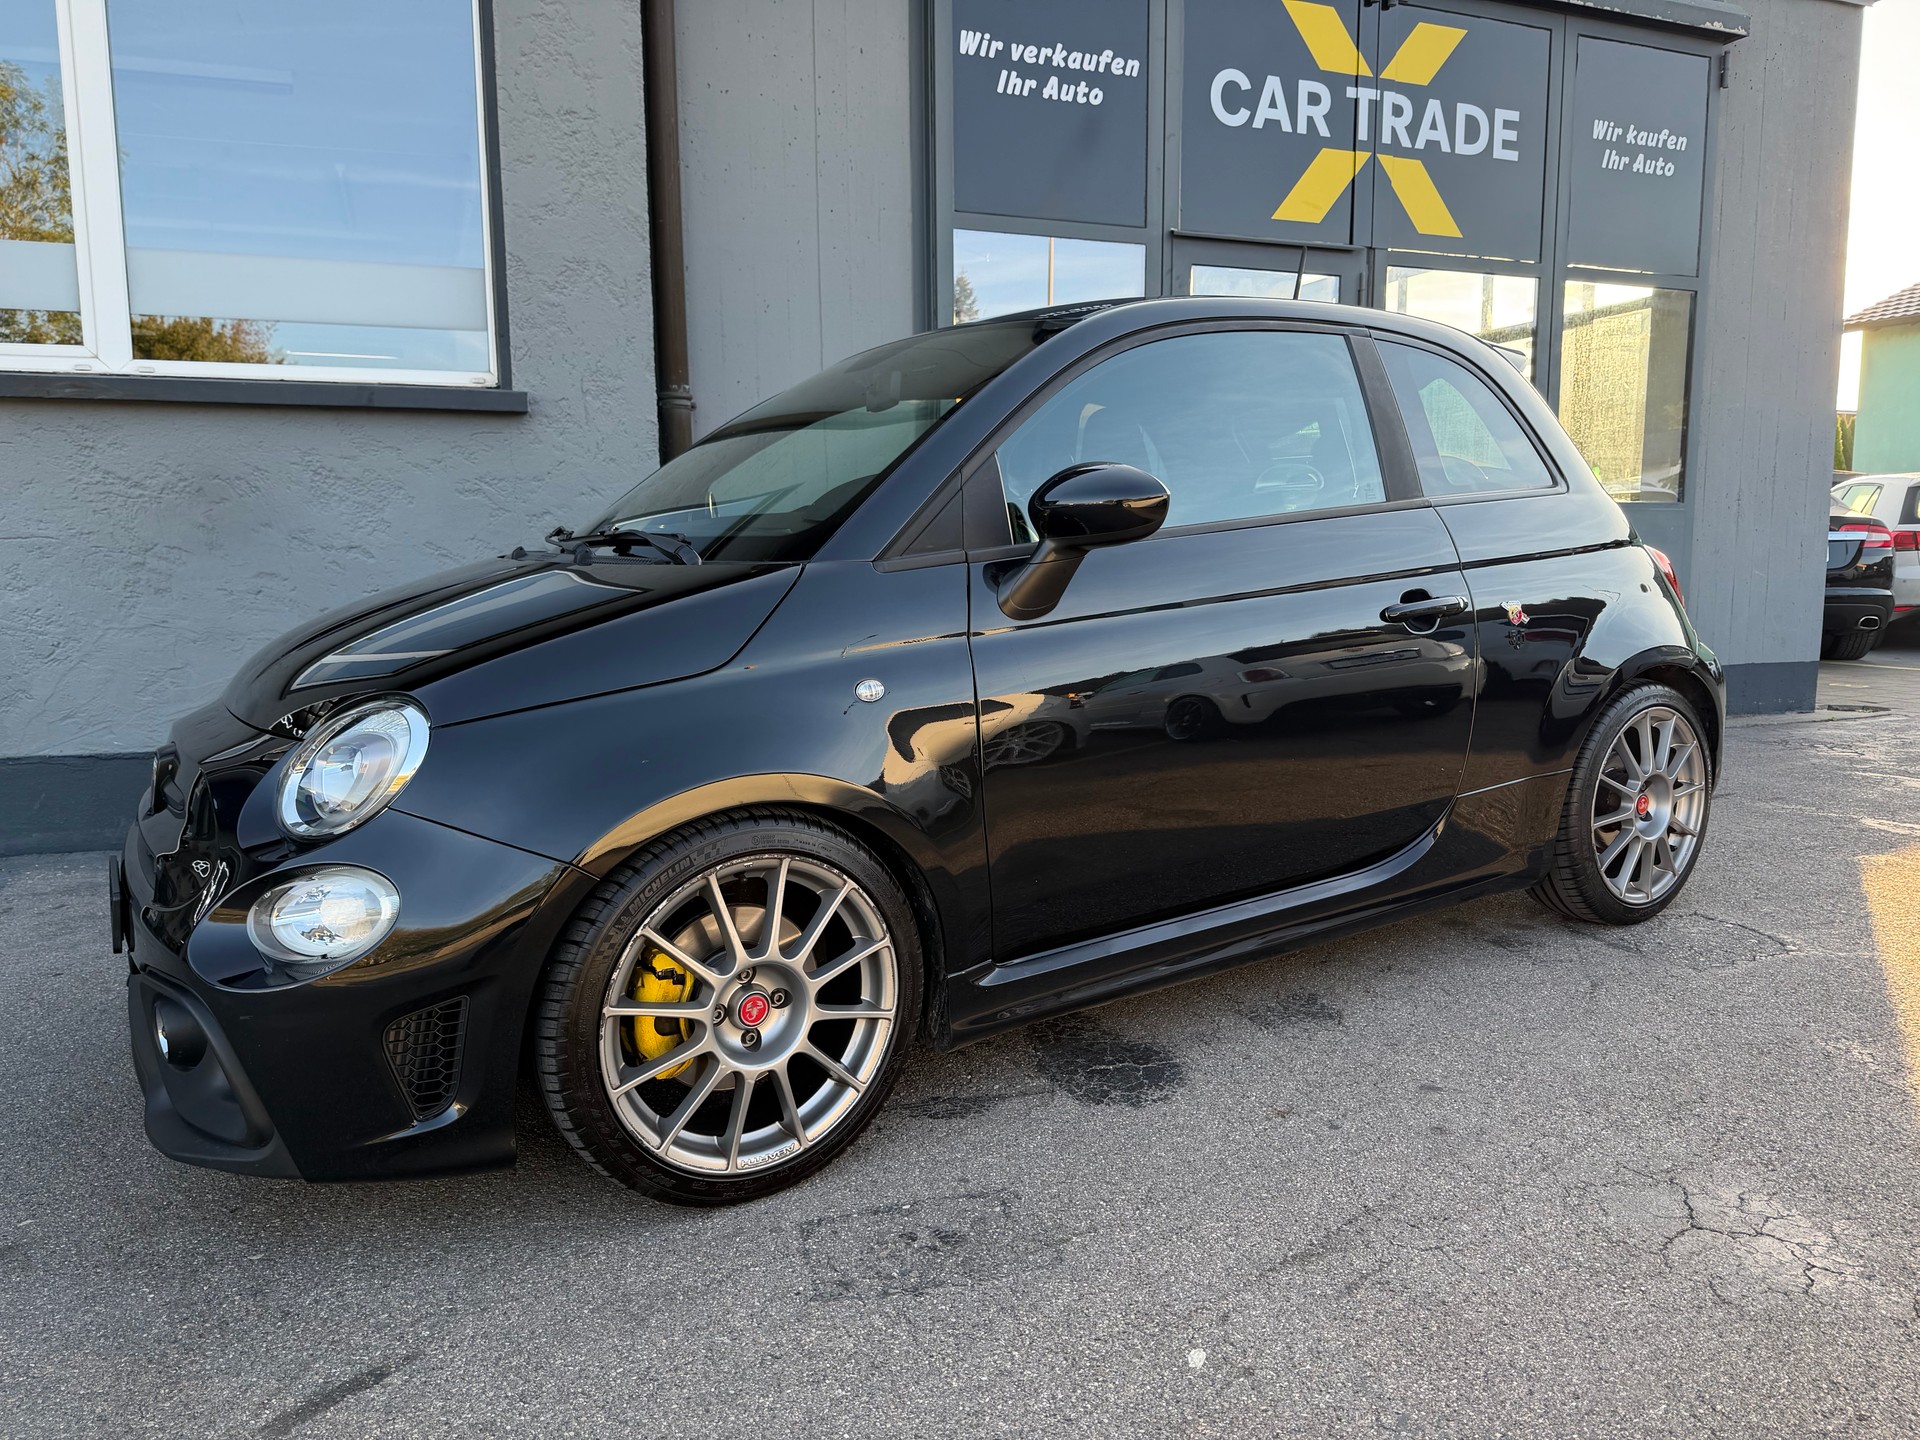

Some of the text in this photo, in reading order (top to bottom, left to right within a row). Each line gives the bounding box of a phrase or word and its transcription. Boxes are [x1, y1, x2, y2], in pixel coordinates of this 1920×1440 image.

[959, 29, 1141, 78] Wir verkaufen
[996, 69, 1104, 106] Ihr Auto
[1210, 68, 1520, 162] CAR TRADE
[1592, 119, 1688, 151] Wir kaufen
[1601, 149, 1675, 177] Ihr Auto
[628, 856, 692, 915] MICHELIN
[741, 1143, 796, 1168] ABARTH
